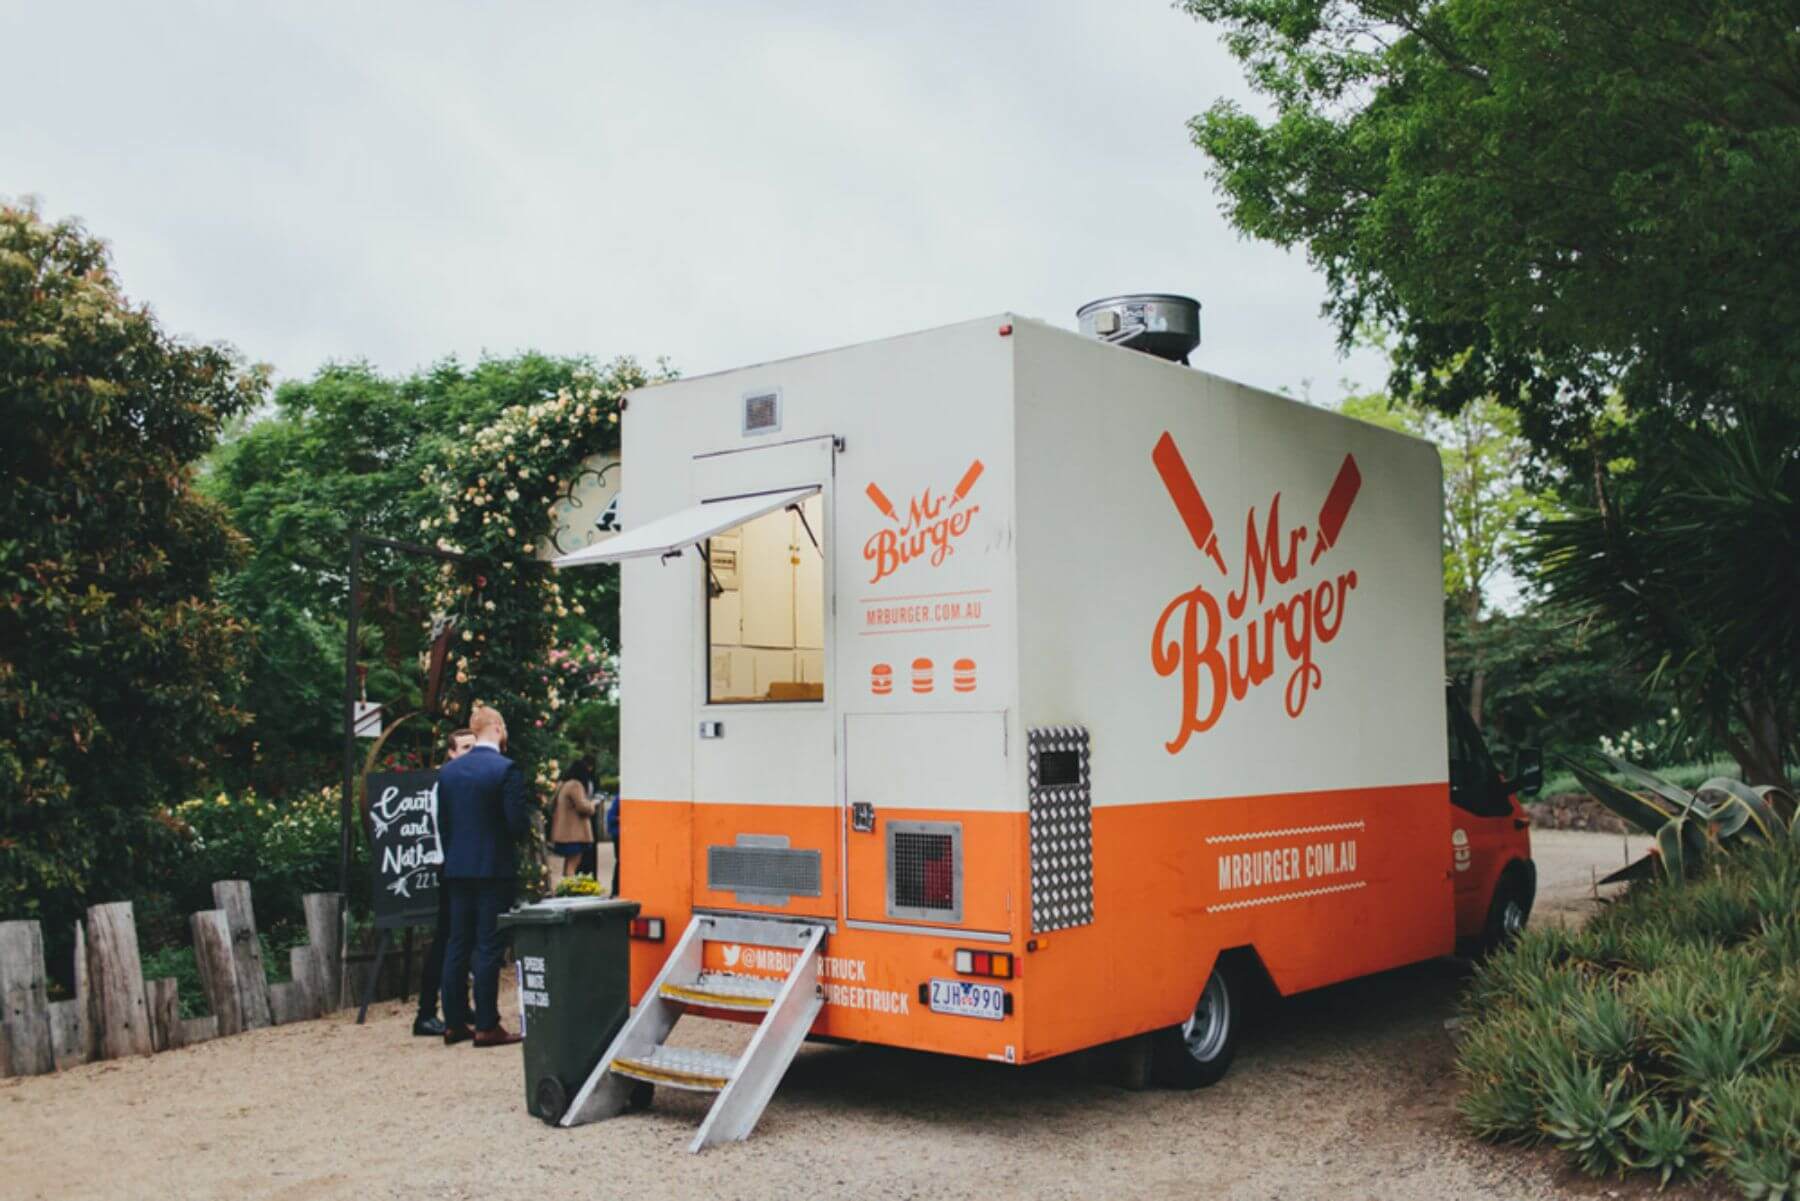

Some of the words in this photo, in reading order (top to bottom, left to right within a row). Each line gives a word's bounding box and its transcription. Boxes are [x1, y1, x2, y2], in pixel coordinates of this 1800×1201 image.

[900, 486, 947, 536] Mr
[863, 504, 979, 584] Burger
[1227, 491, 1307, 620] Mr
[866, 602, 982, 625] MRBURGER.COM.AU
[1151, 569, 1357, 755] Burger
[400, 814, 430, 836] and
[1218, 847, 1300, 891] MRBURGER
